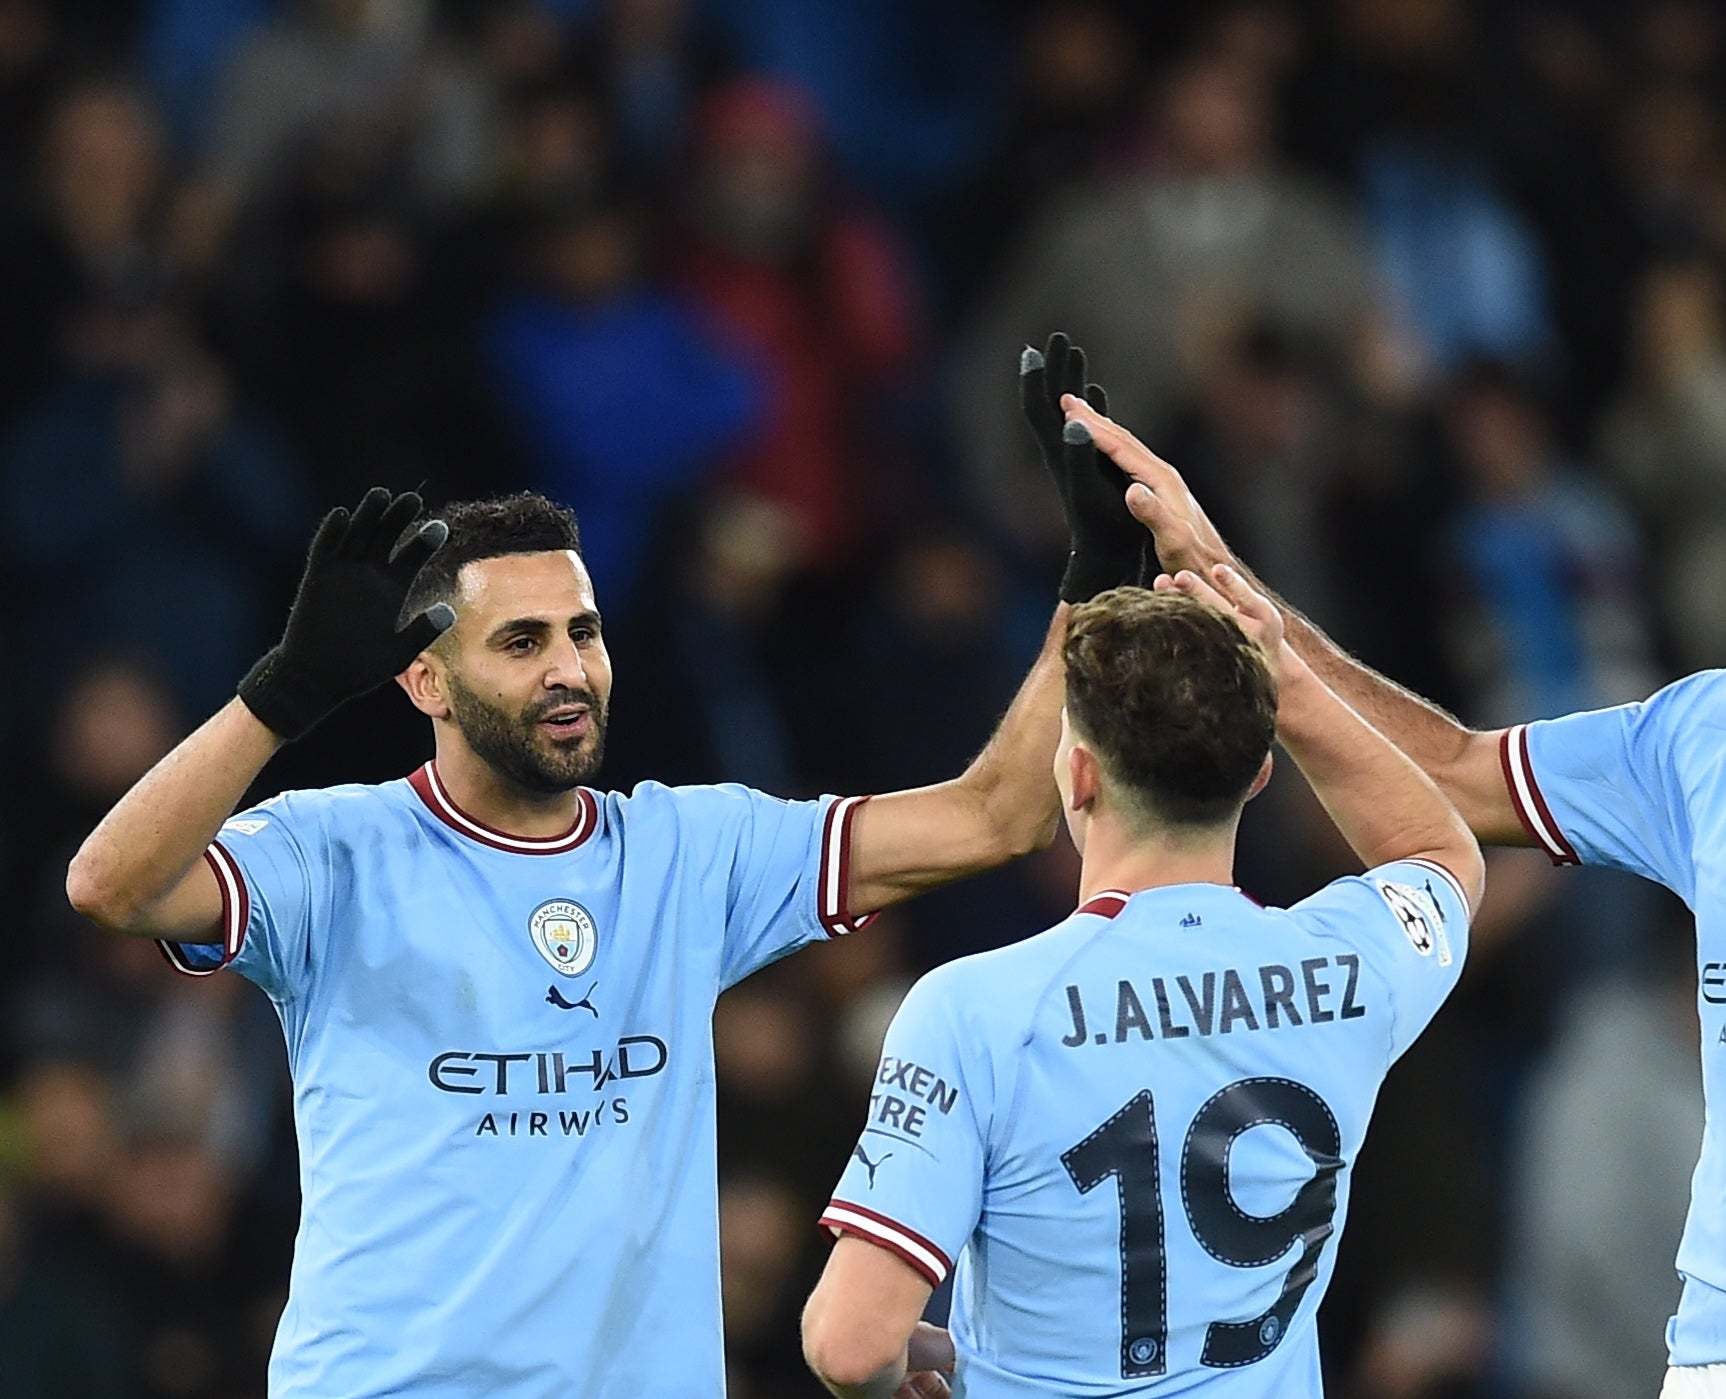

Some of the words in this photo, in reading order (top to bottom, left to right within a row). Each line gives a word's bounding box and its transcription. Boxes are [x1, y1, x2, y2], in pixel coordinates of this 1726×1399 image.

[533, 905, 590, 930] MANCHESTER
[557, 963, 576, 973] CITY
[1061, 953, 1366, 1048] J.ALVAREZ
[1060, 1076, 1346, 1380] 19
